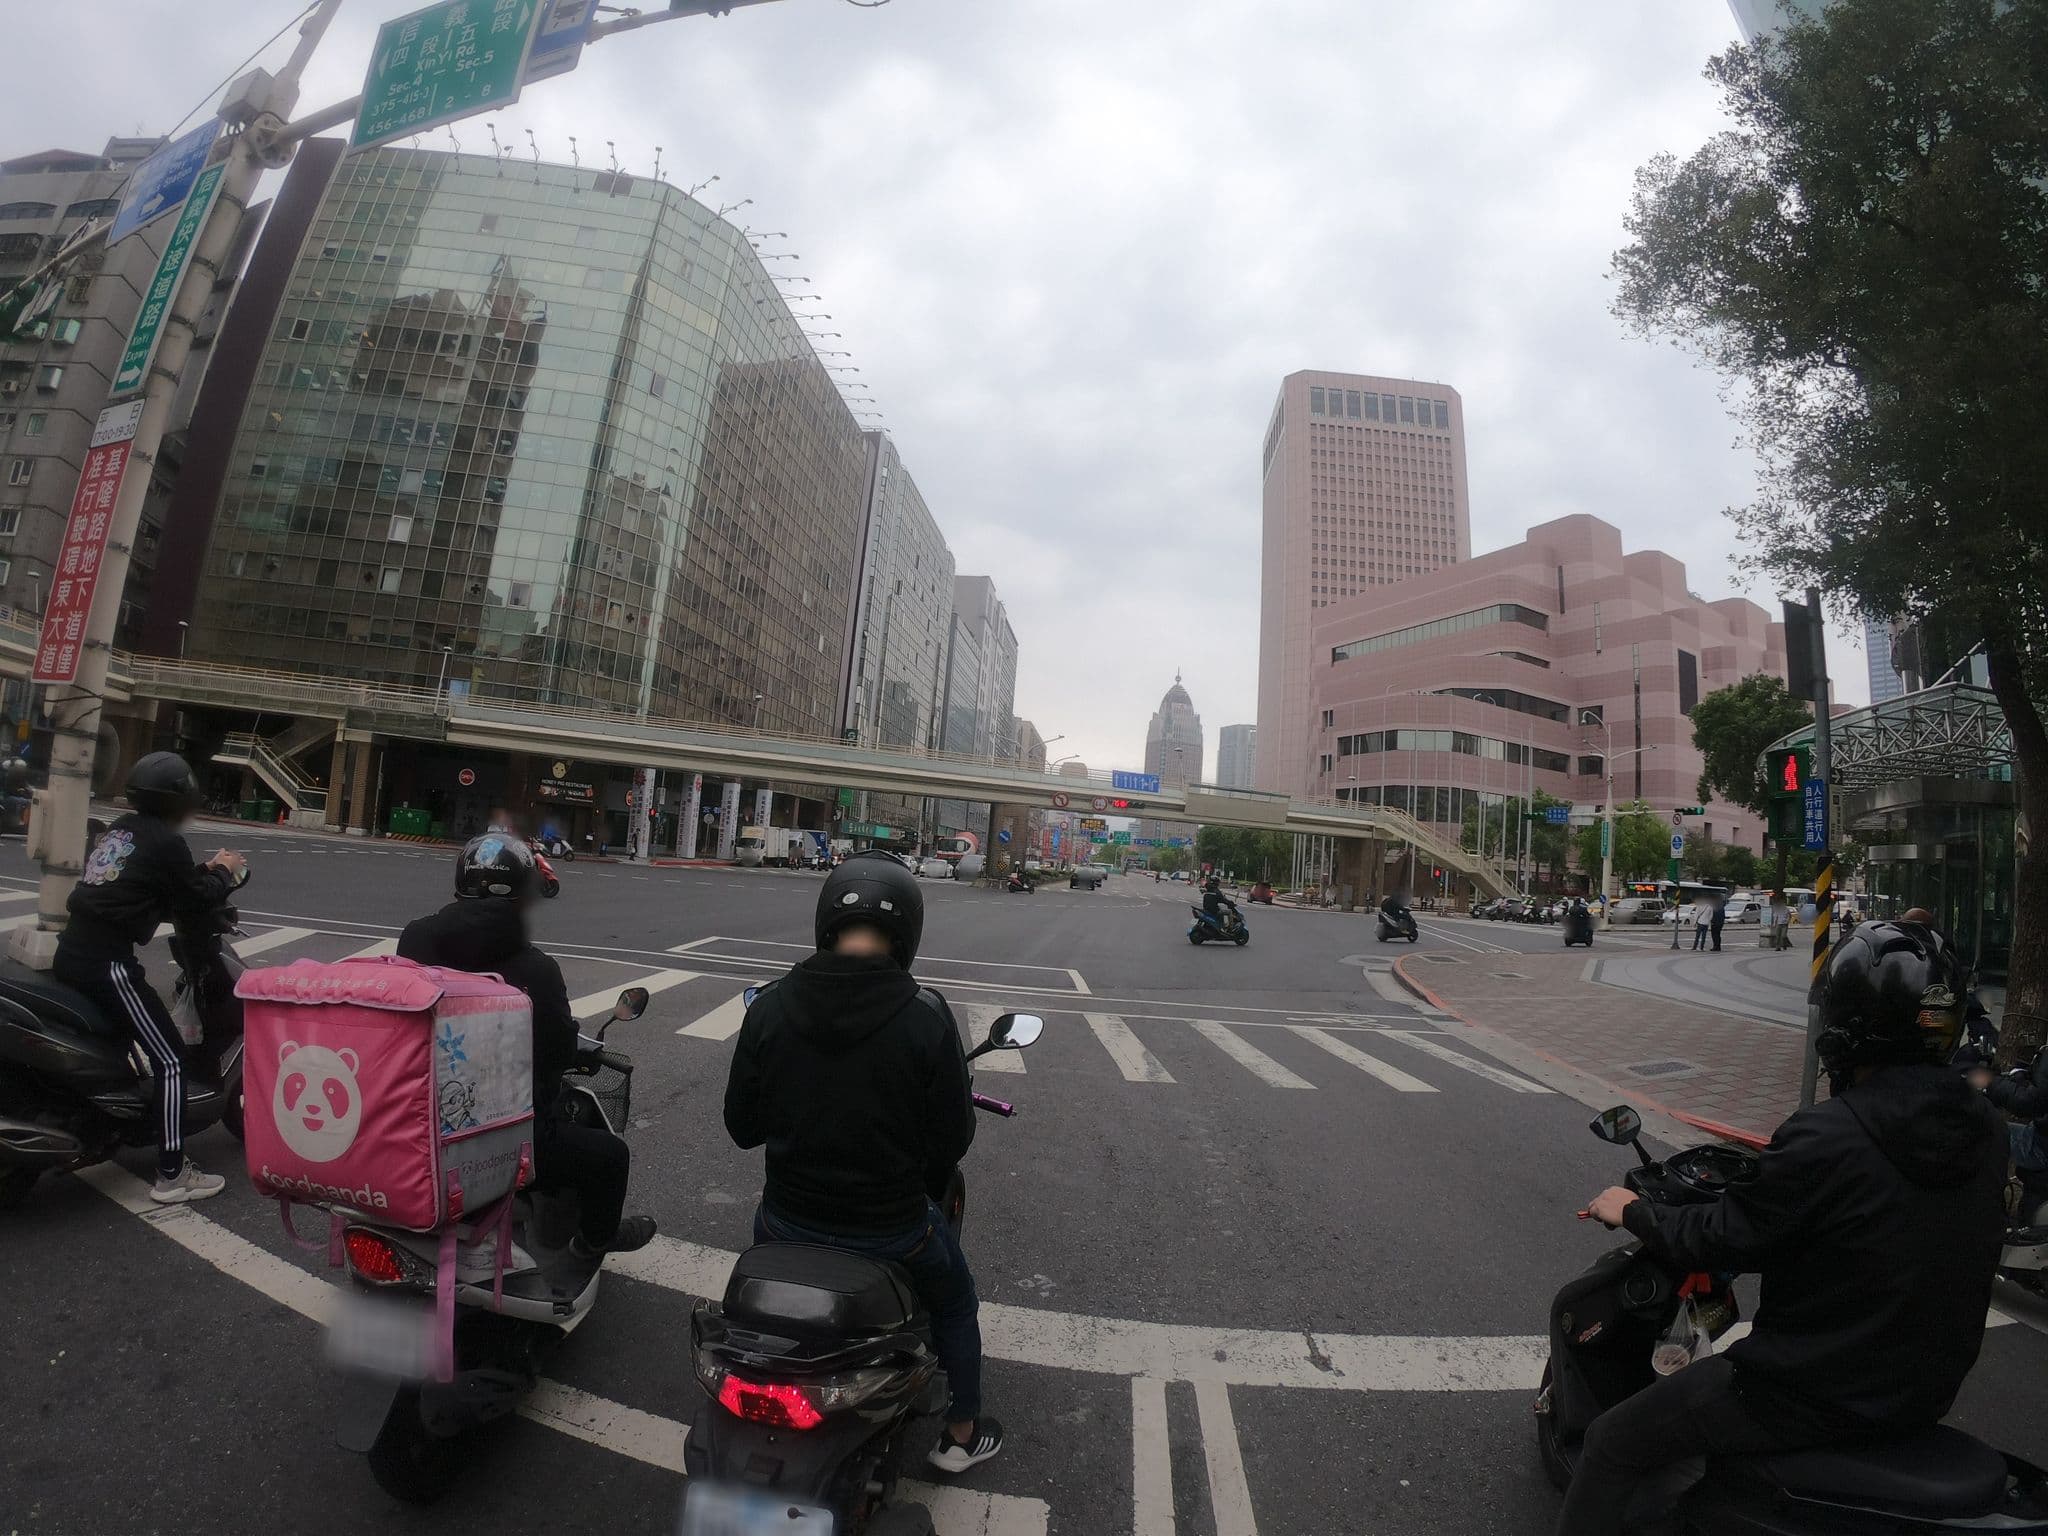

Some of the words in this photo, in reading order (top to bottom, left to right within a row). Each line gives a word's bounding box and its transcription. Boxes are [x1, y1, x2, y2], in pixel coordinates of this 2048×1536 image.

[367, 107, 426, 136] 456-468
[141, 170, 221, 328] 信義快速道路
[39, 454, 105, 674] 准行駛環東大道
[1805, 786, 1814, 843] 自行車共用
[1814, 785, 1824, 842] 人行道行人
[262, 1165, 389, 1209] foodpanda
